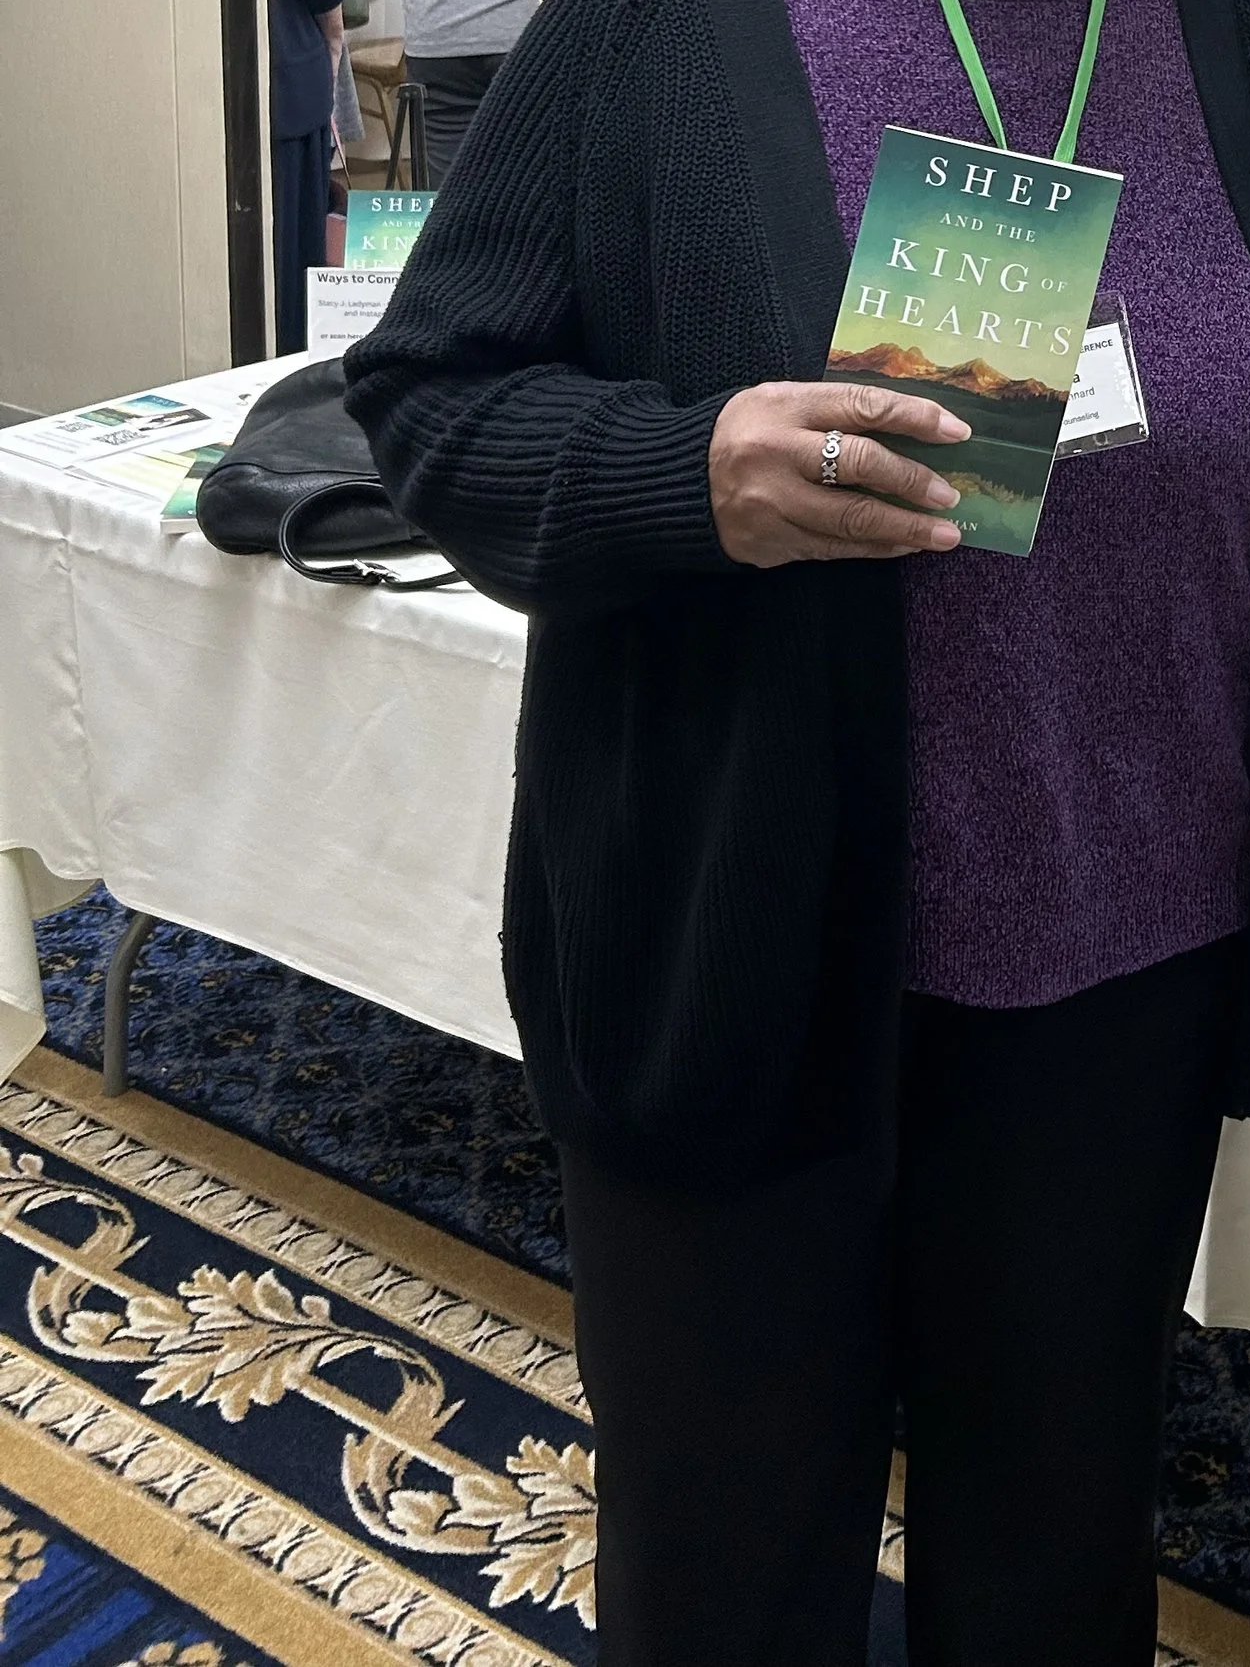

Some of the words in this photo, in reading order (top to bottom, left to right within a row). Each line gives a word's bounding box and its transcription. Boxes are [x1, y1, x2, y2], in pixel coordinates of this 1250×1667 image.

[925, 156, 1072, 212] SHEP
[382, 220, 402, 228] AND
[940, 213, 983, 231] AND
[996, 223, 1036, 242] THE
[362, 235, 409, 250] KIN
[886, 237, 1029, 293] KING
[1041, 278, 1068, 292] OF
[317, 273, 349, 285] Ways
[352, 274, 364, 283] to
[368, 274, 399, 284] Conn
[854, 285, 1072, 356] HEARTS
[1063, 411, 1099, 425] ounseling
